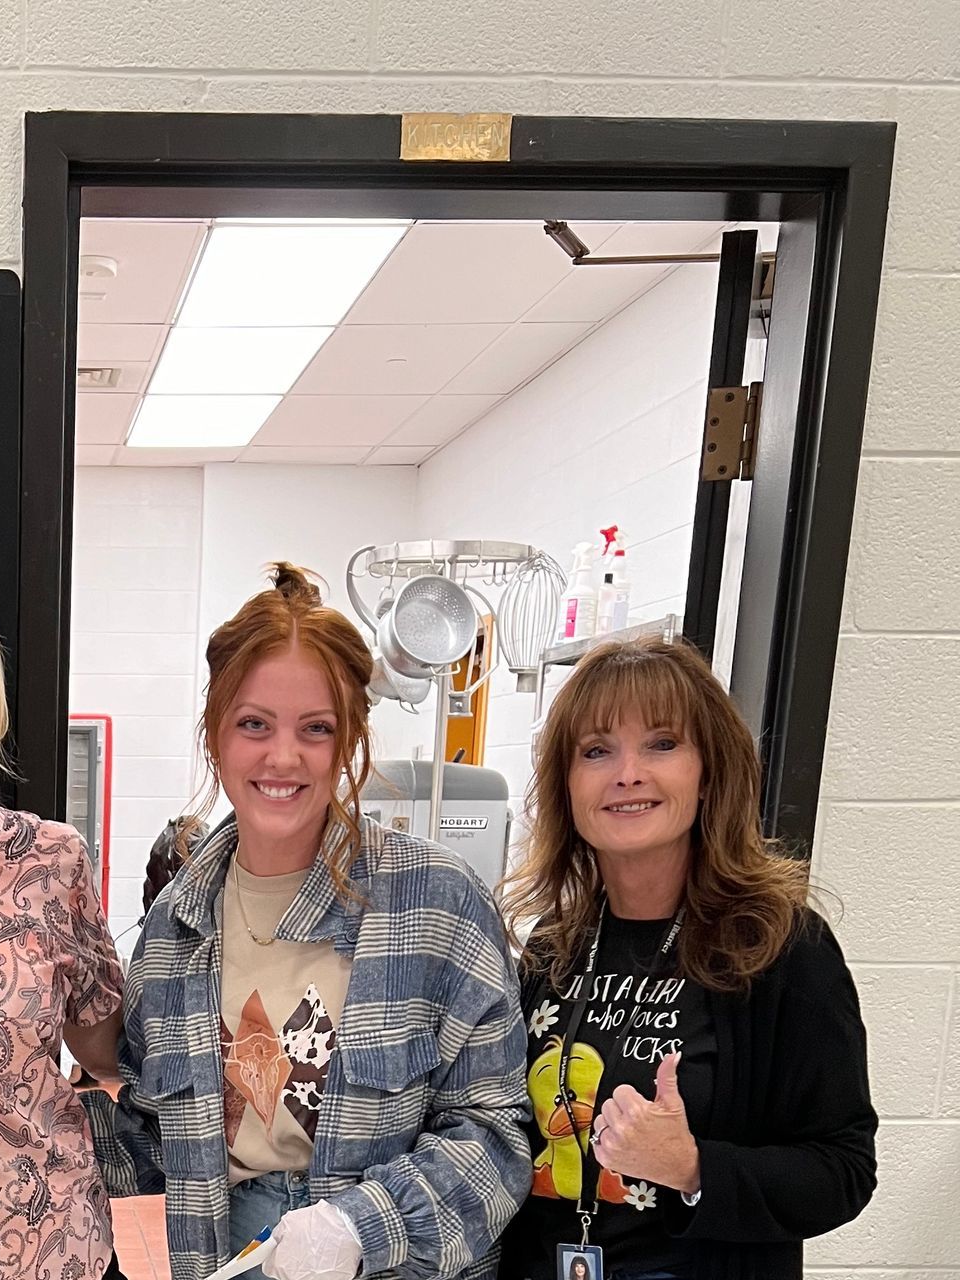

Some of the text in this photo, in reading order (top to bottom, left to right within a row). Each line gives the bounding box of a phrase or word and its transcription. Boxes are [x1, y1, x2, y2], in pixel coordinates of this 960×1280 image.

[406, 121, 505, 148] KITCHEN
[613, 975, 634, 1001] A
[586, 1002, 681, 1031] who loves
[616, 1035, 684, 1064] UCKS
